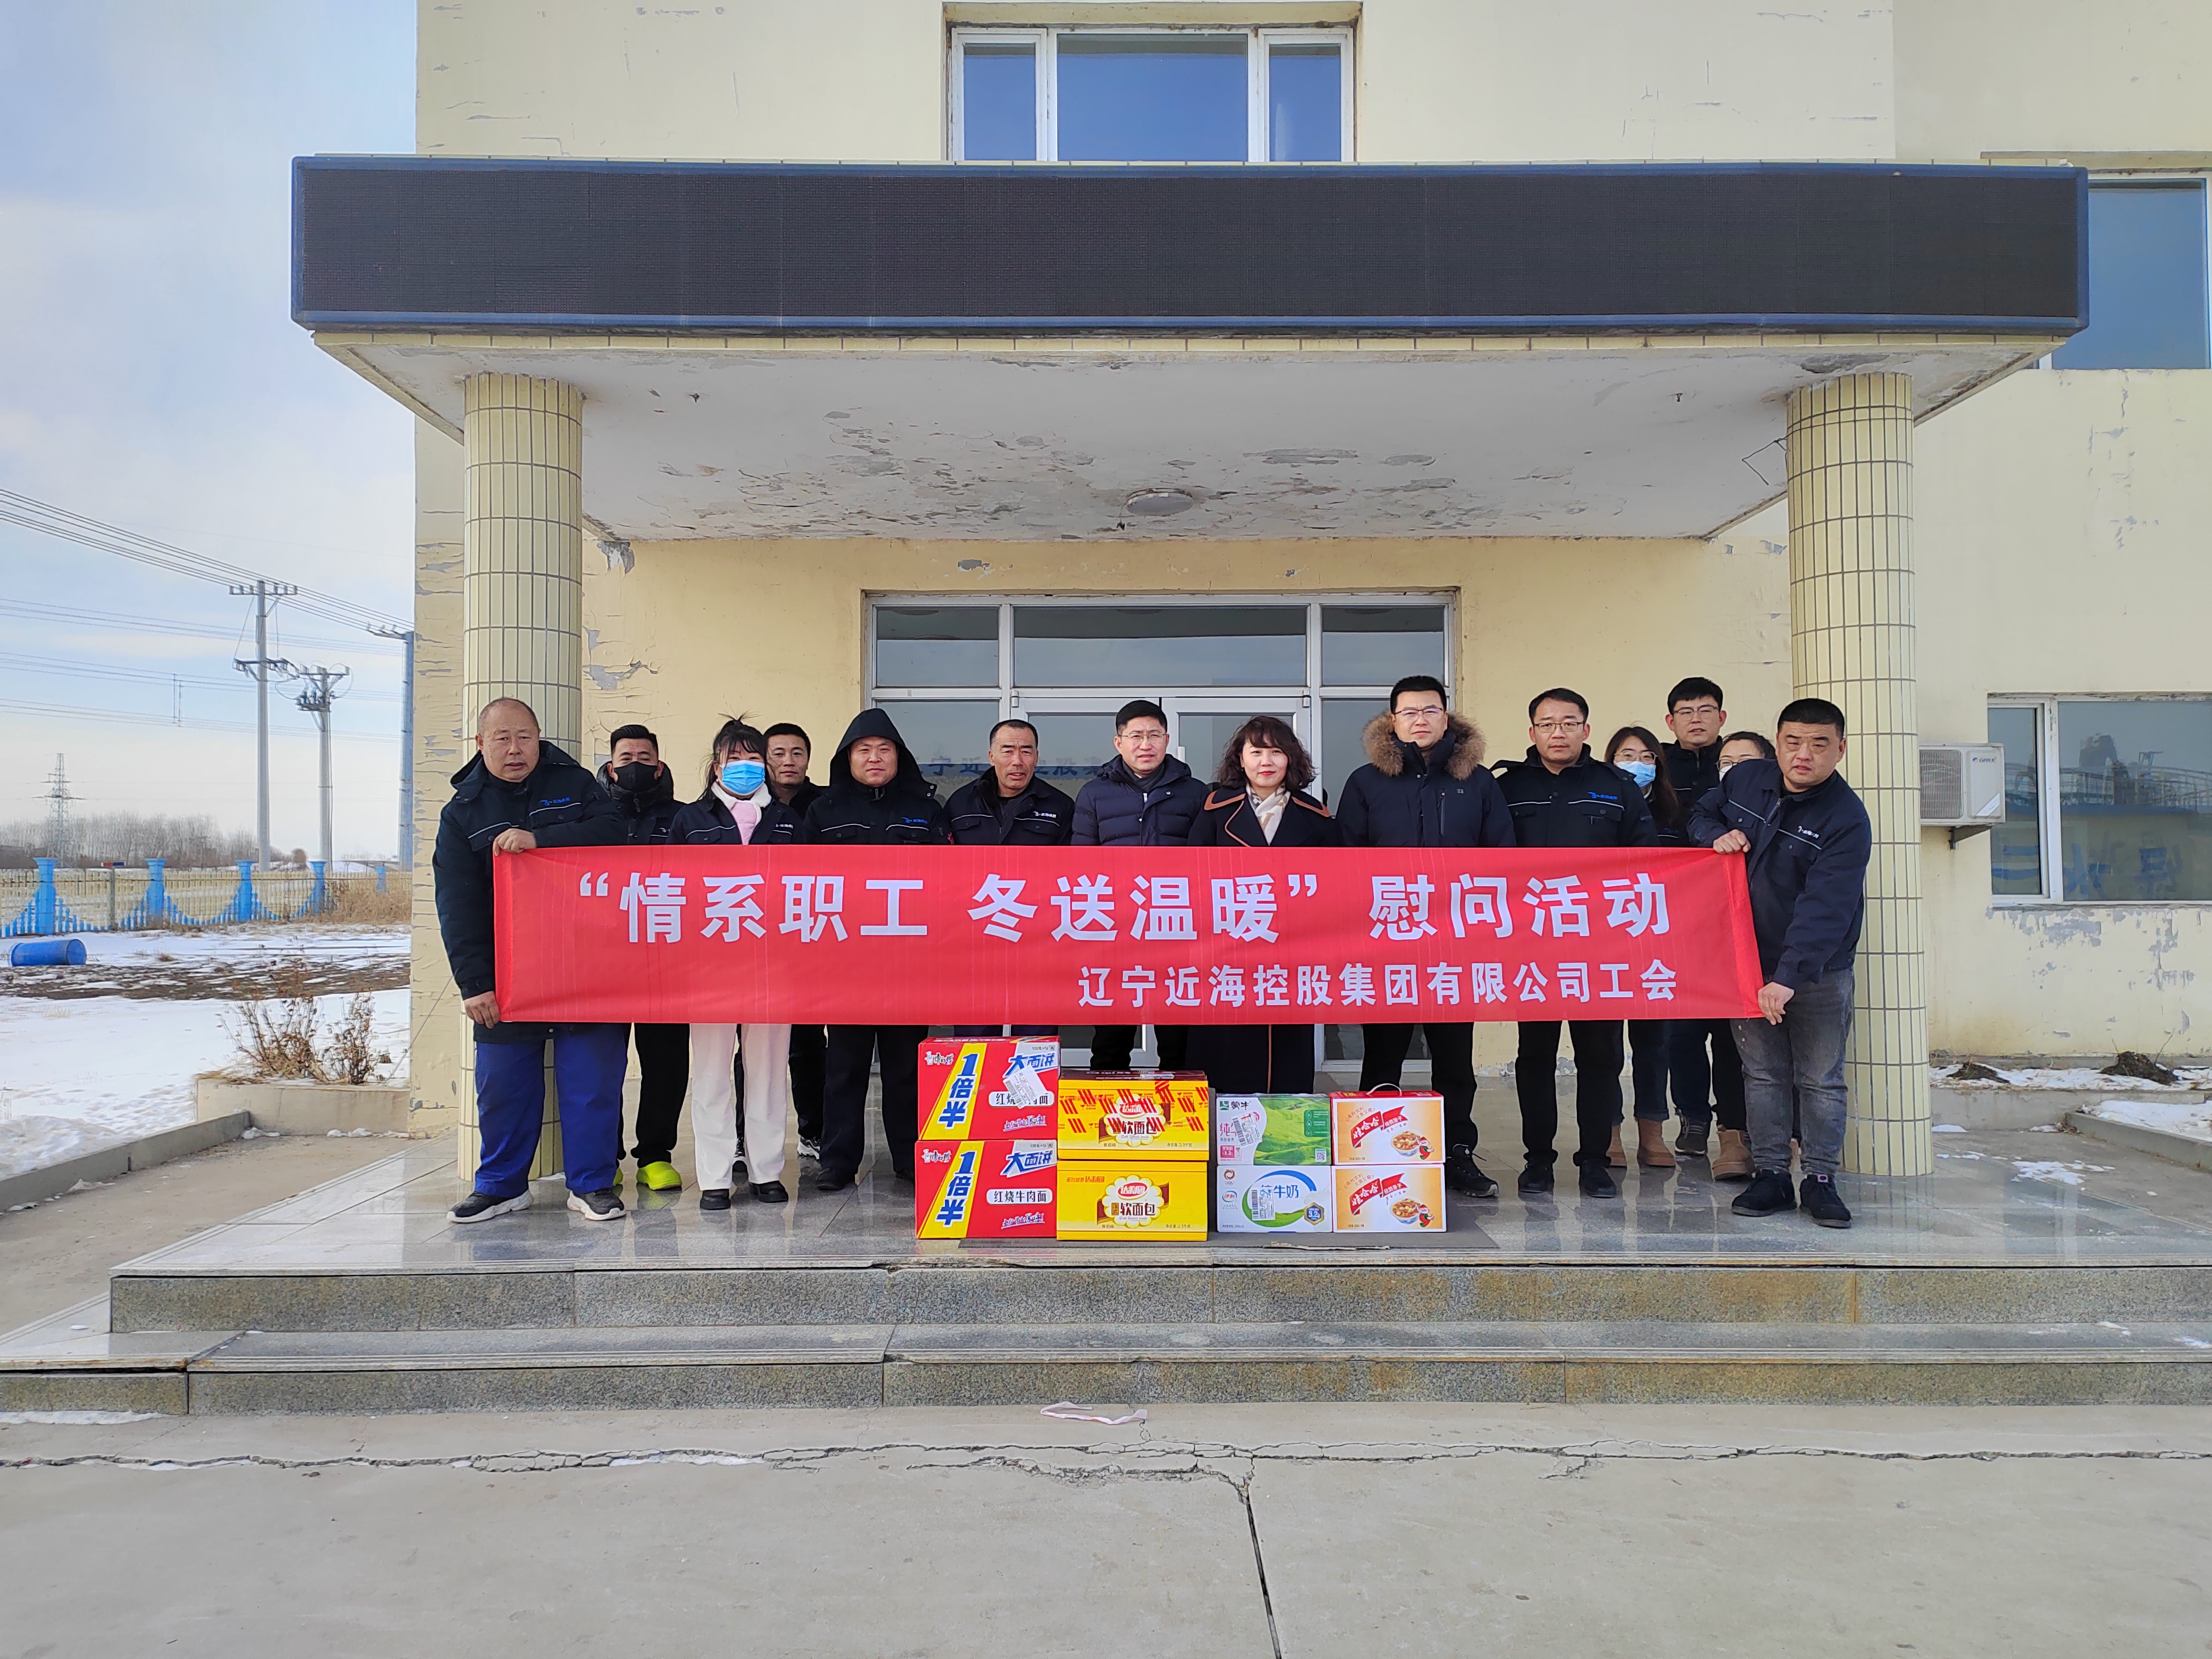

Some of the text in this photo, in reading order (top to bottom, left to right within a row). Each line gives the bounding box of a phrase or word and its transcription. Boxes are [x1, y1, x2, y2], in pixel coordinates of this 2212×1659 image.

[579, 871, 1670, 943] “情系职工 冬送温暖” 慰问活动
[1078, 958, 1677, 1008] 辽宁近海控股集团有限公司工会
[938, 1053, 979, 1128] 1倍半
[1231, 1100, 1249, 1111] 蒙牛
[1353, 1117, 1380, 1139] 娃哈哈
[1001, 1150, 1053, 1175] 大面饼
[935, 1151, 976, 1226] 1倍半
[994, 1190, 1047, 1203] 红烧牛肉面
[1351, 1184, 1379, 1206] 娃哈哈
[1120, 1202, 1156, 1216] 软面包
